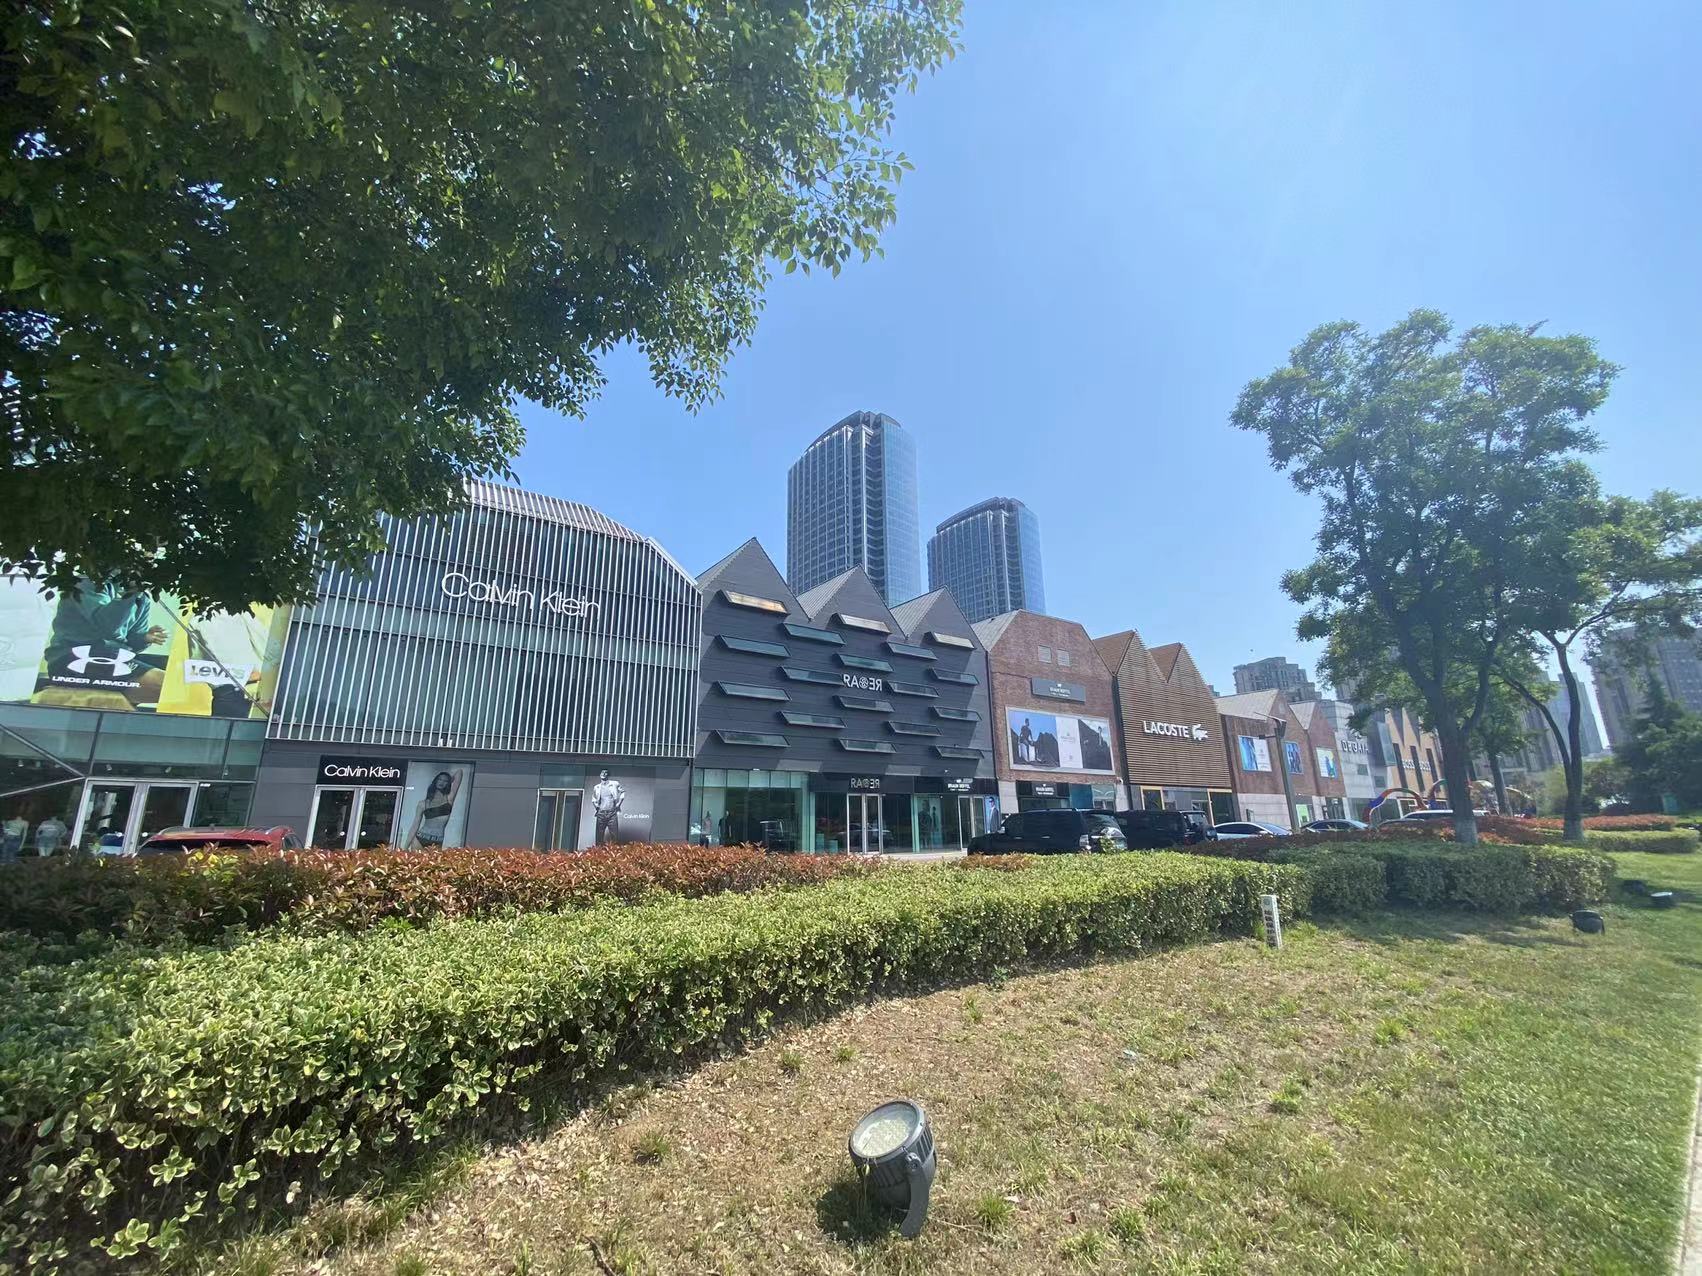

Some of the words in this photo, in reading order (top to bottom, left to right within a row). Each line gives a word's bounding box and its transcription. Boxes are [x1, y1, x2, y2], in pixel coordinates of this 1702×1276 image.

[441, 572, 534, 610] Calvin
[539, 587, 601, 621] Klein
[52, 675, 90, 684] UNDER
[92, 679, 141, 688] ARMOUR
[1143, 720, 1190, 738] LACOSTE
[324, 764, 368, 777] Calvin
[369, 766, 401, 778] Klein
